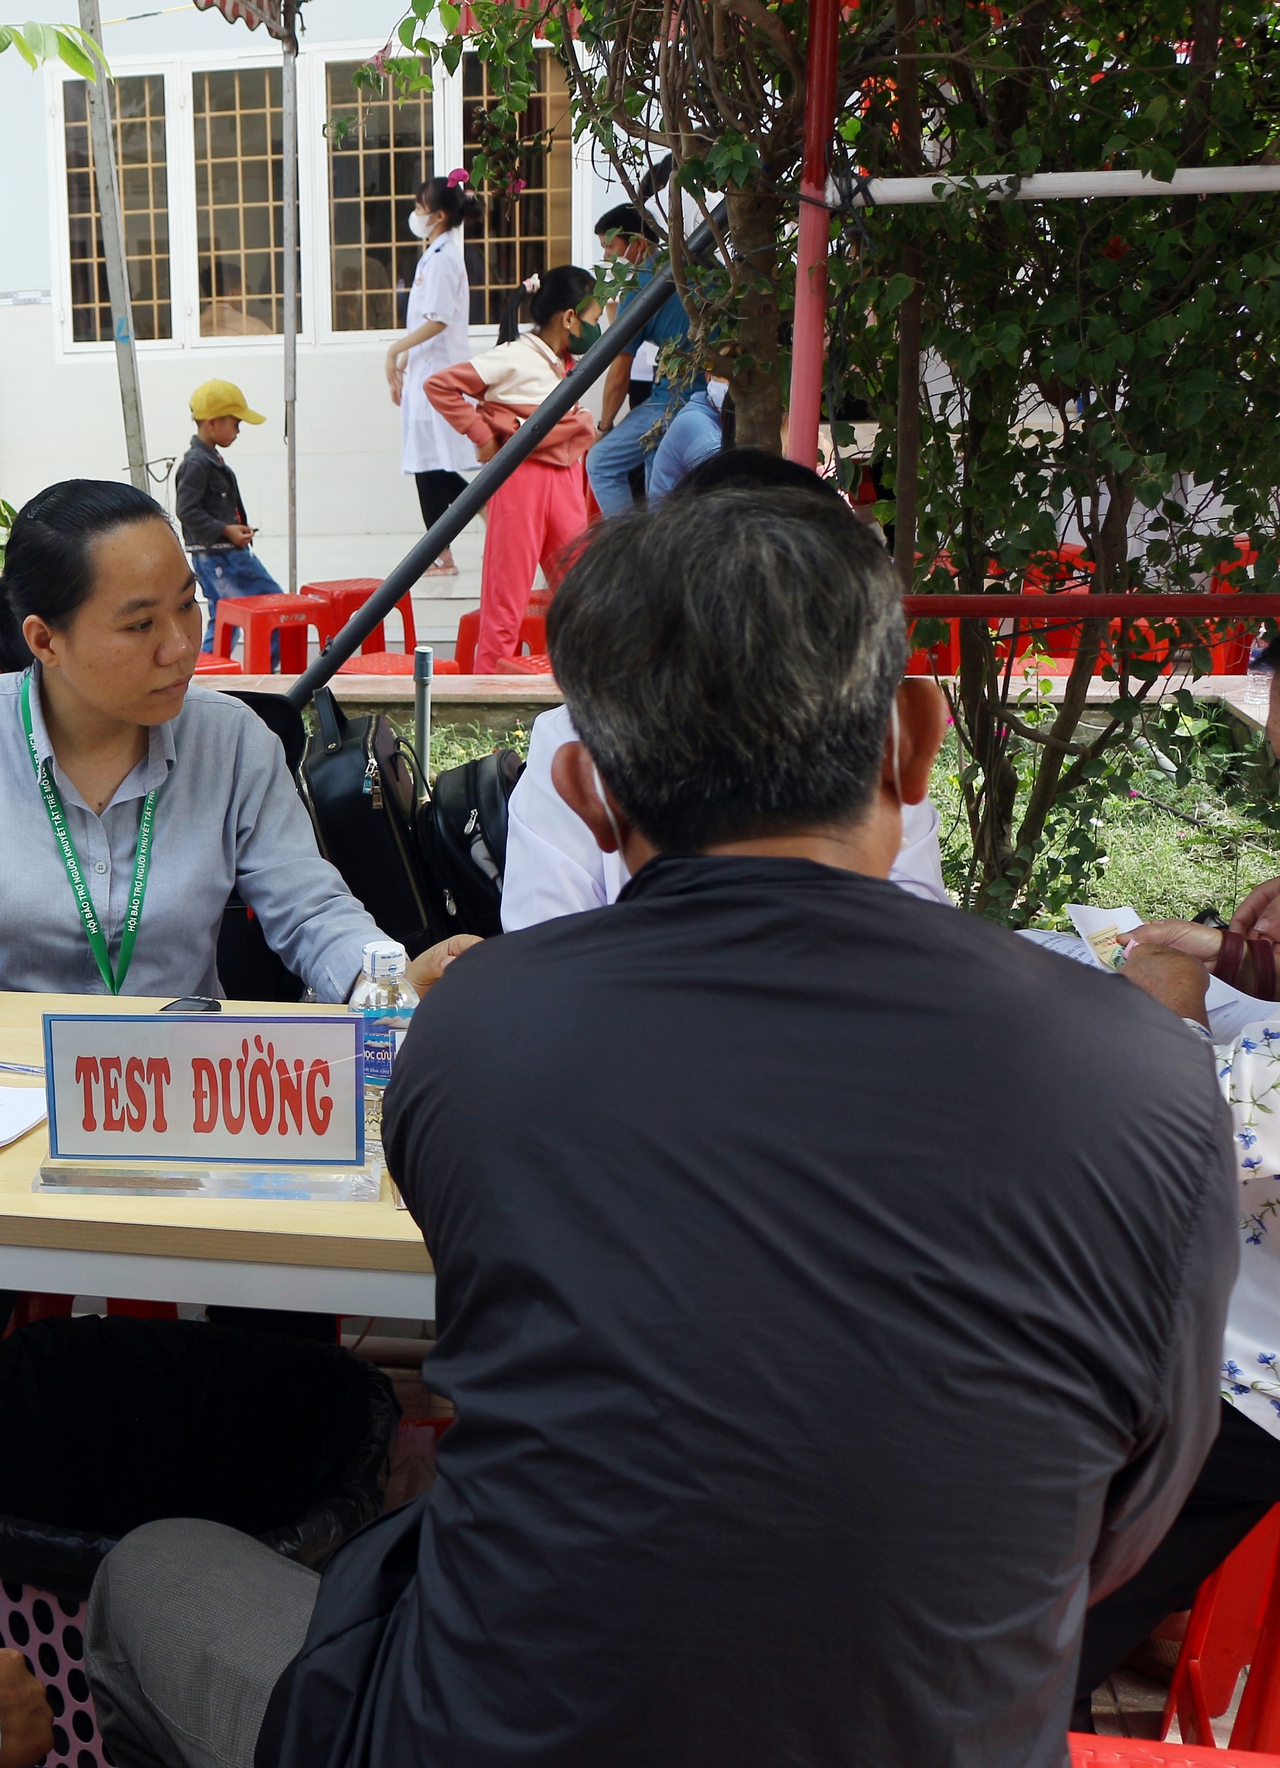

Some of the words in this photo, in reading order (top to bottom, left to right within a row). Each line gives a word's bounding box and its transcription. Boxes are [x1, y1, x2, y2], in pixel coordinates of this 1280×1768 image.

[54, 827, 73, 859] KHUYẾT
[74, 884, 86, 901] TRỢ
[133, 880, 144, 897] TRỢ
[81, 901, 94, 919] BẢO
[129, 899, 140, 917] BẢO
[87, 919, 98, 934] HỘI
[127, 918, 138, 932] HỘI
[75, 1055, 171, 1133] TEST
[191, 1034, 334, 1136] ĐƯỜNG
